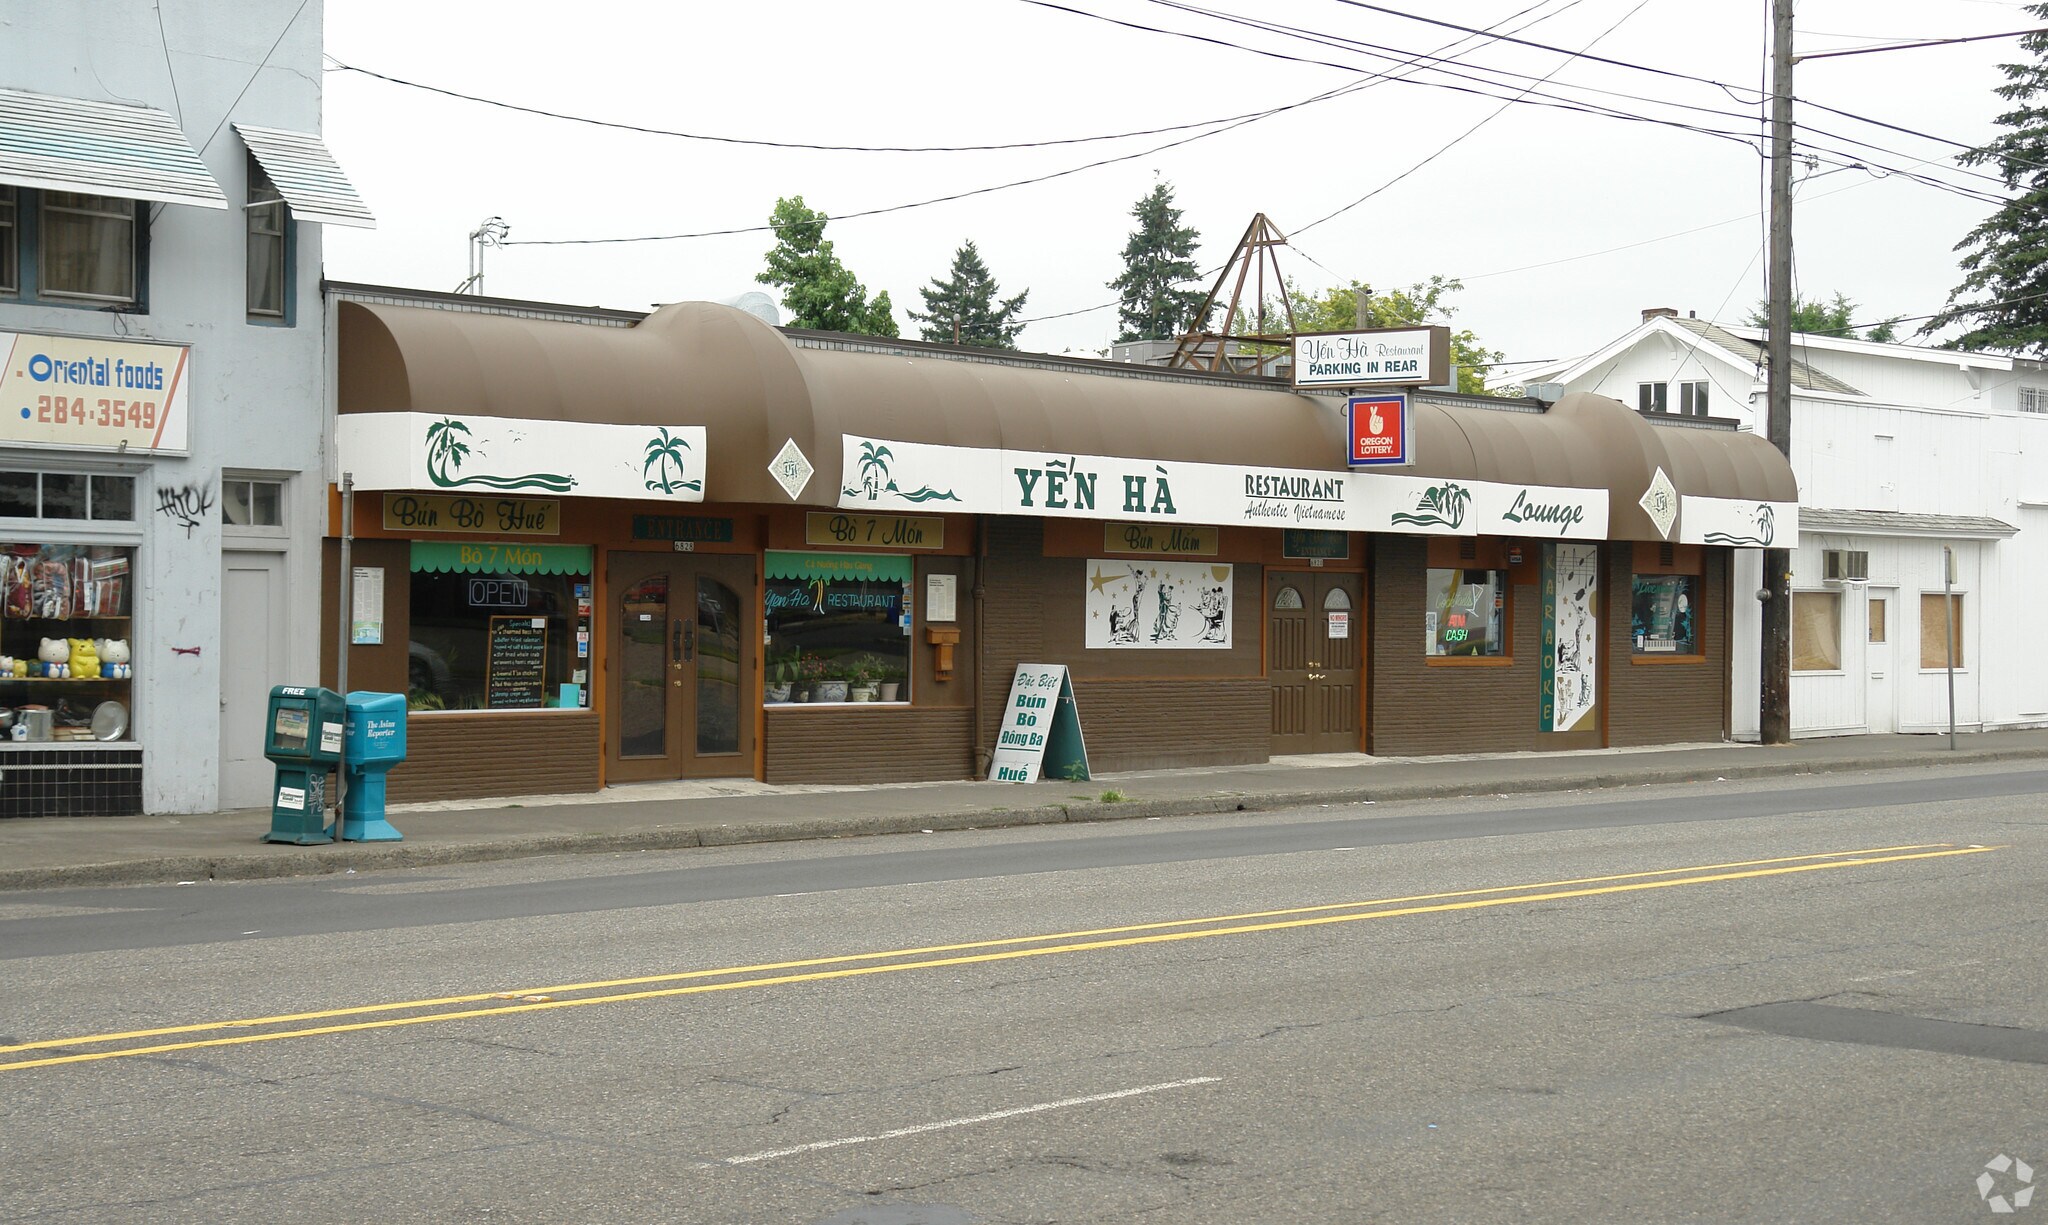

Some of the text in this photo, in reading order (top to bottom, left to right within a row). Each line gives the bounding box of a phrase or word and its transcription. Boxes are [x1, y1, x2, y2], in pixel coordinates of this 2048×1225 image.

[1301, 337, 1424, 364] Yến Hà Restaurant
[28, 353, 163, 390] Oriental foods
[1309, 359, 1418, 376] PARKING IN REAR
[1360, 437, 1393, 446] OREGON
[1014, 456, 1177, 515] YẾN HÀ
[1245, 474, 1344, 500] RESTAURANT
[392, 496, 551, 531] Bún Bò Huế
[1243, 499, 1346, 523] Authentic Vietnamese
[1502, 488, 1585, 536] Lounge
[647, 518, 722, 540] ENTRANCE
[829, 515, 923, 545] Bò 7 Món
[1124, 525, 1153, 550] Bún
[460, 545, 543, 566] Bò 7 Món
[675, 542, 694, 551] 6828
[471, 580, 527, 606] OPEN
[827, 593, 896, 608] RESTAURANT
[1435, 591, 1474, 609] Cocktails
[1448, 614, 1466, 627] ATM
[1445, 629, 1469, 642] CASH
[1542, 554, 1555, 720] KARAOKE
[282, 687, 306, 696] FREE
[1015, 693, 1047, 709] Bún
[367, 720, 396, 729] The Asian
[1016, 711, 1037, 727] Bò
[367, 729, 396, 739] Reporter
[1001, 730, 1044, 747] Đông Ba
[997, 763, 1029, 782] Huế
